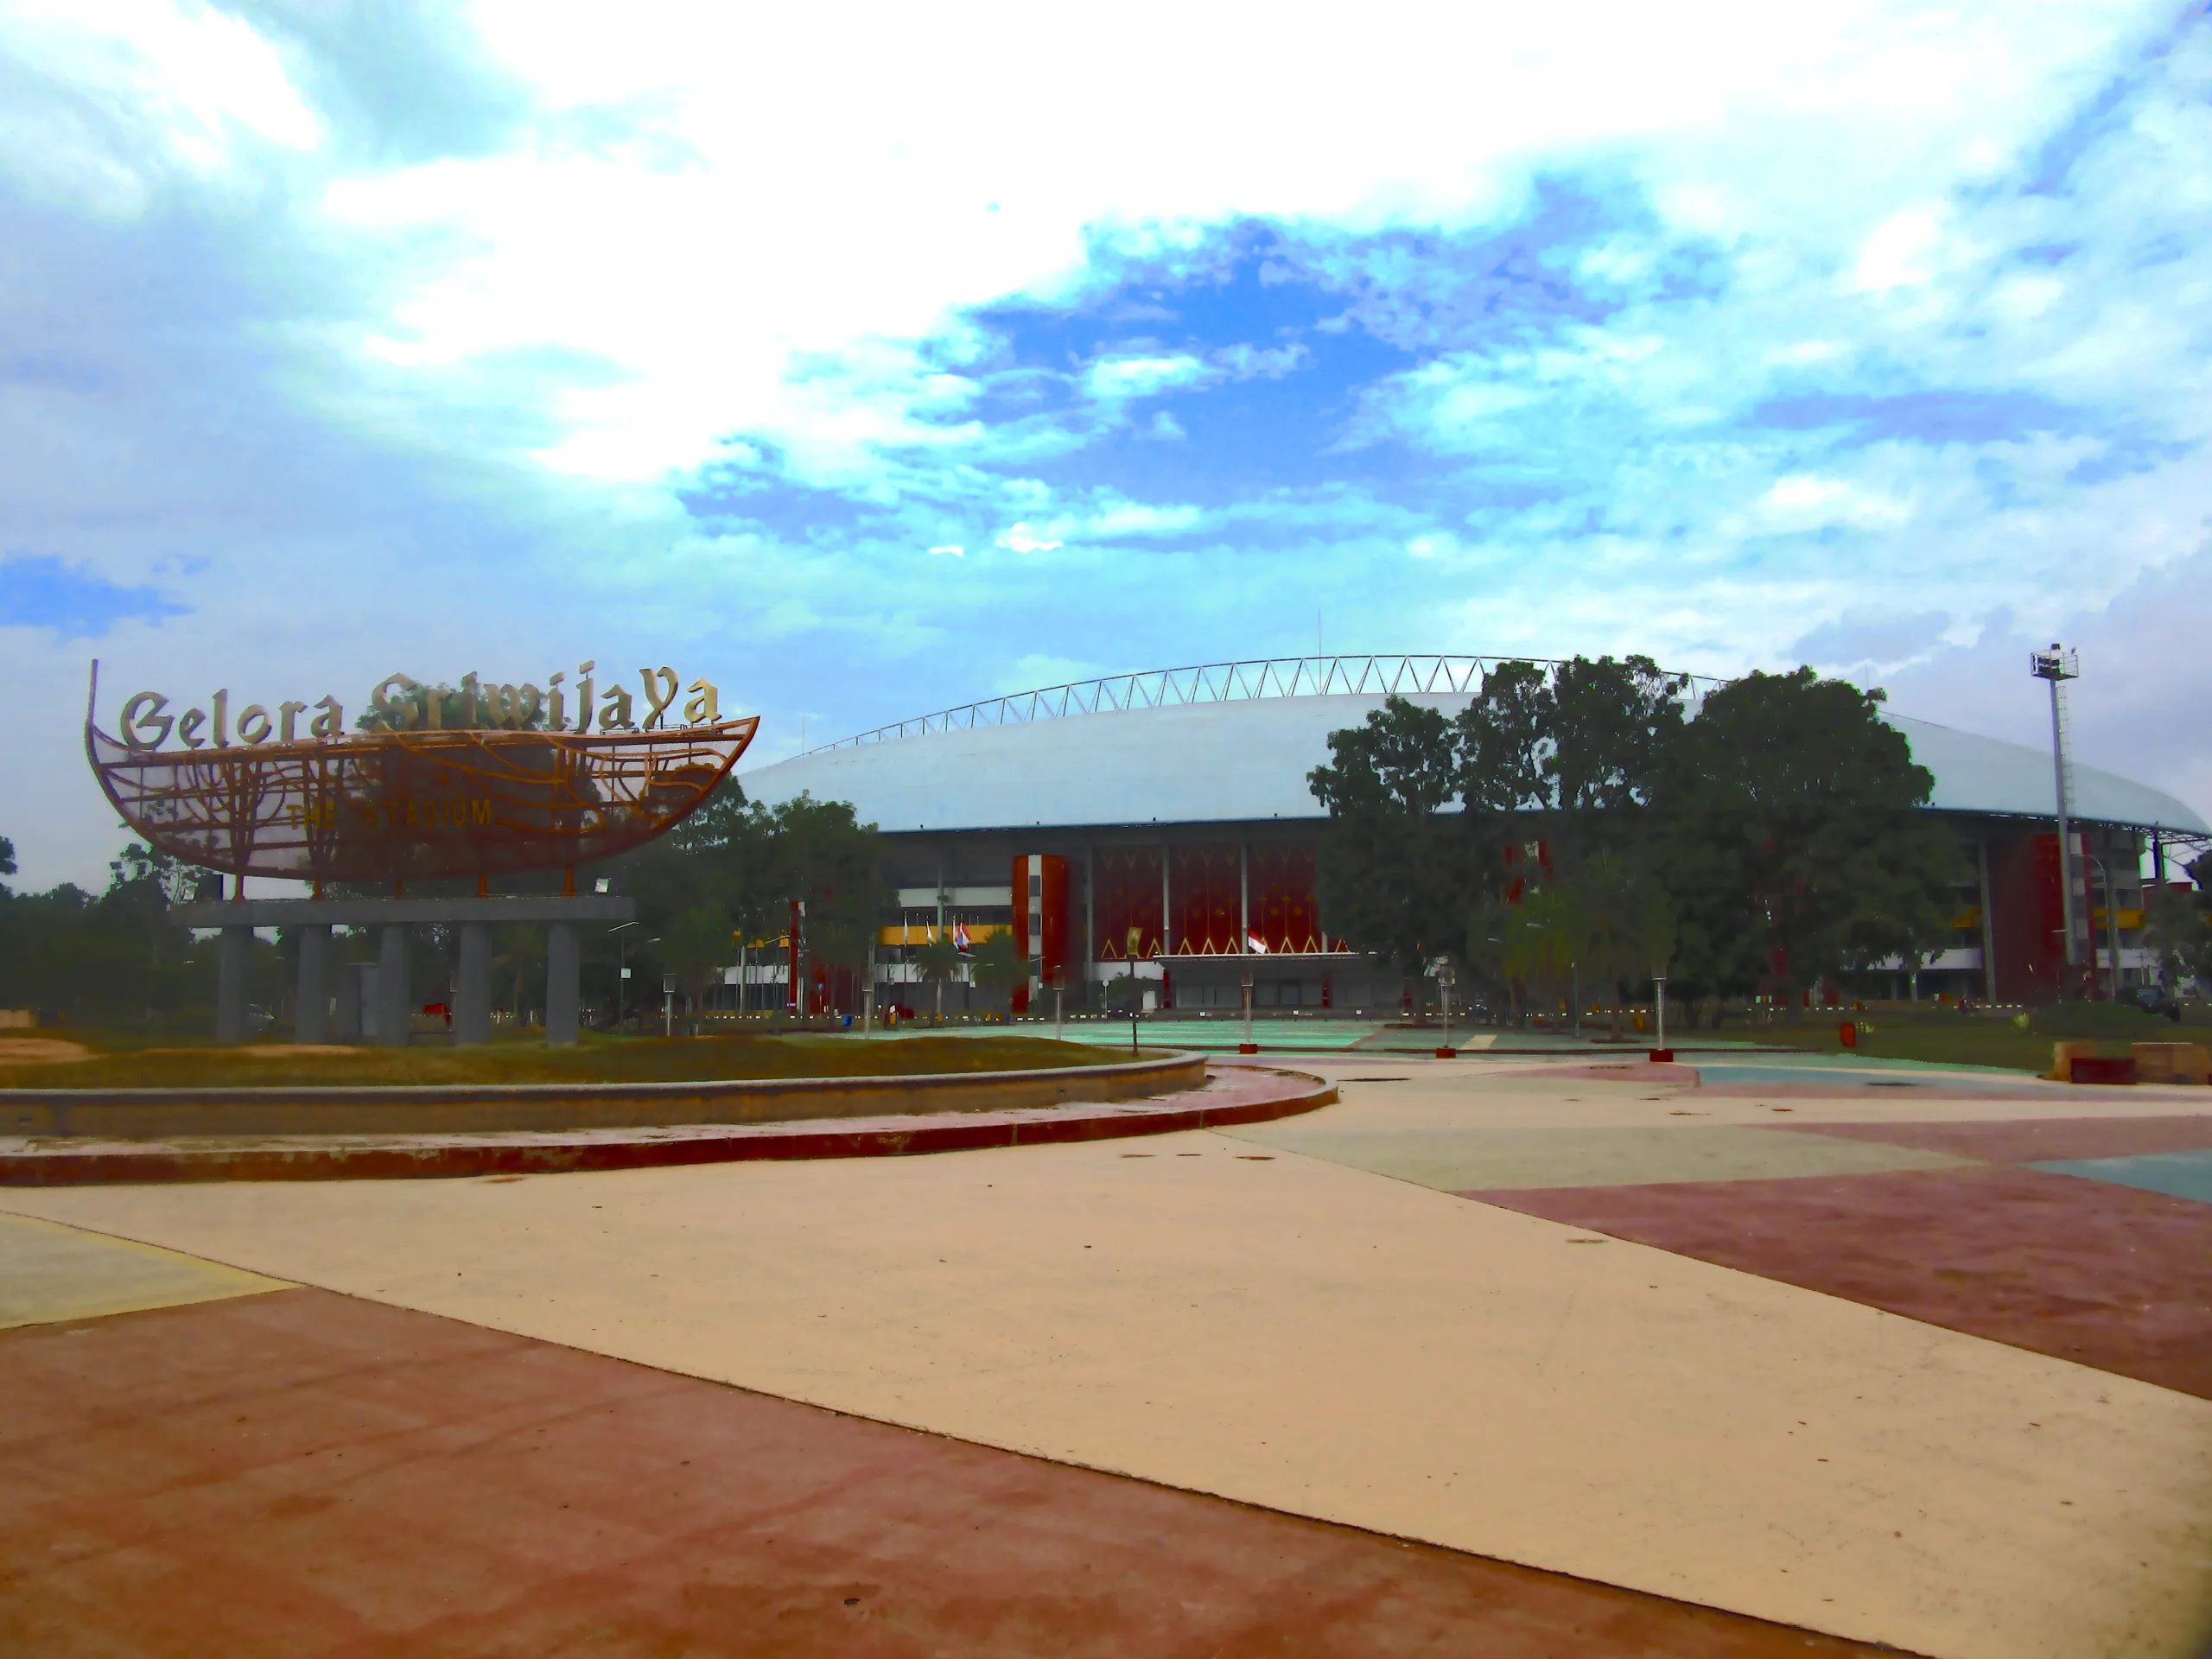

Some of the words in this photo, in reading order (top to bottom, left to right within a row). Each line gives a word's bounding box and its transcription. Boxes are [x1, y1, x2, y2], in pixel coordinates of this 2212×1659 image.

[120, 689, 346, 750] Gelora
[286, 803, 338, 830] THE
[360, 797, 492, 829] STADIUM
